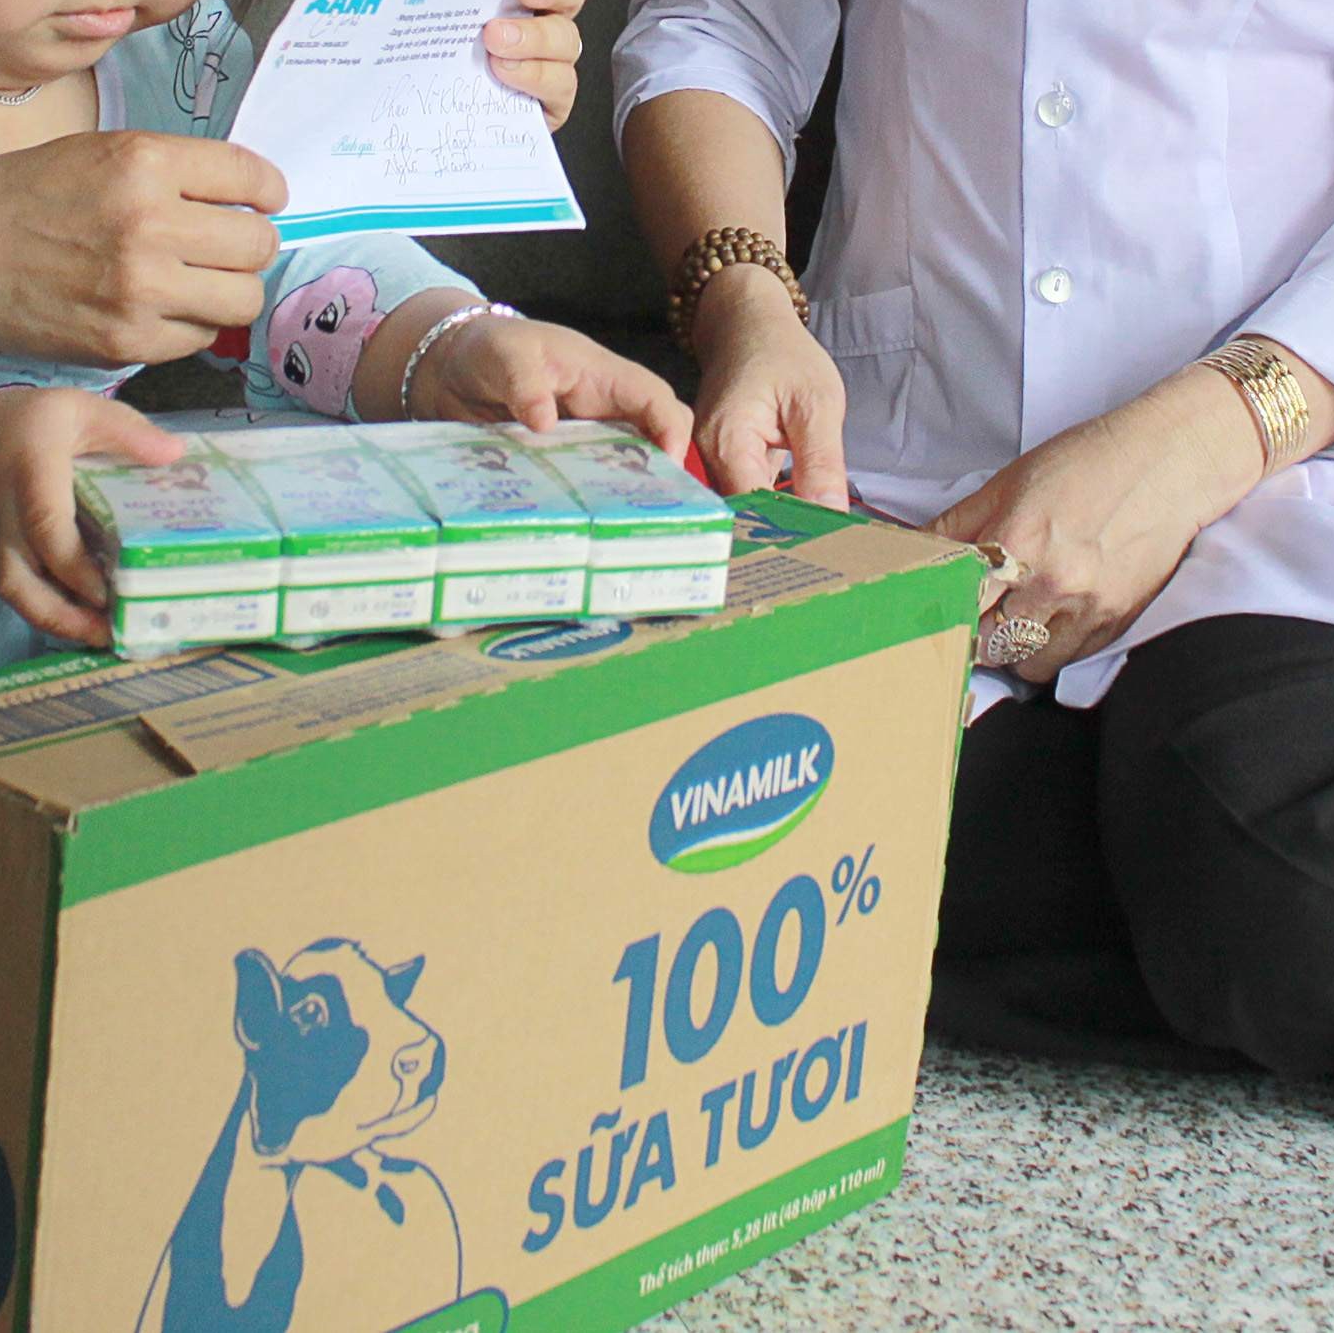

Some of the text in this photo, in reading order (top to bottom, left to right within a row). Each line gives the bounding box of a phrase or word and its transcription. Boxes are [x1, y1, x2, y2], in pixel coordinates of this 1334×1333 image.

[670, 742, 821, 831] VINAMILK
[612, 843, 881, 1092] 100%
[520, 1019, 868, 1254] SỮA TƯƠI
[638, 1262, 667, 1297] Thể
[730, 1221, 761, 1251] 5,28
[778, 1199, 800, 1228] (48
[801, 1188, 828, 1214] hộp
[827, 1184, 837, 1200] x
[838, 1173, 863, 1196] 110
[863, 1157, 886, 1183] ml)
